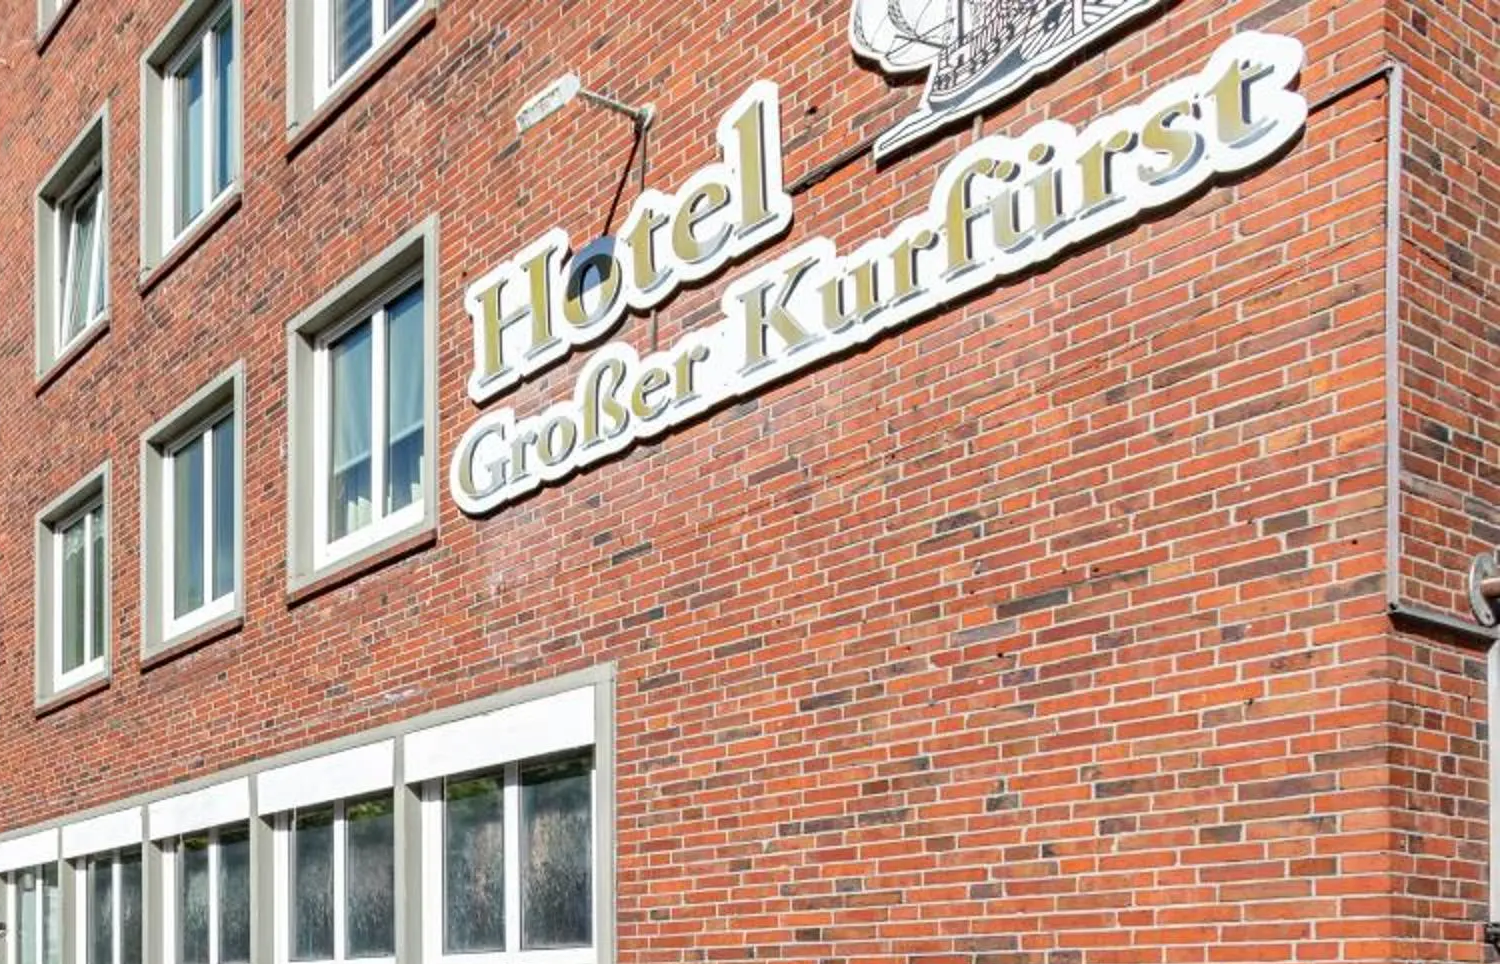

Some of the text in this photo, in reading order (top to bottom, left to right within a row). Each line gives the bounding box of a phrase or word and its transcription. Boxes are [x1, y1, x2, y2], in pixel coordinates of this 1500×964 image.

[458, 56, 1279, 501] Großer Kurfürst
[475, 98, 771, 384] Hotel
